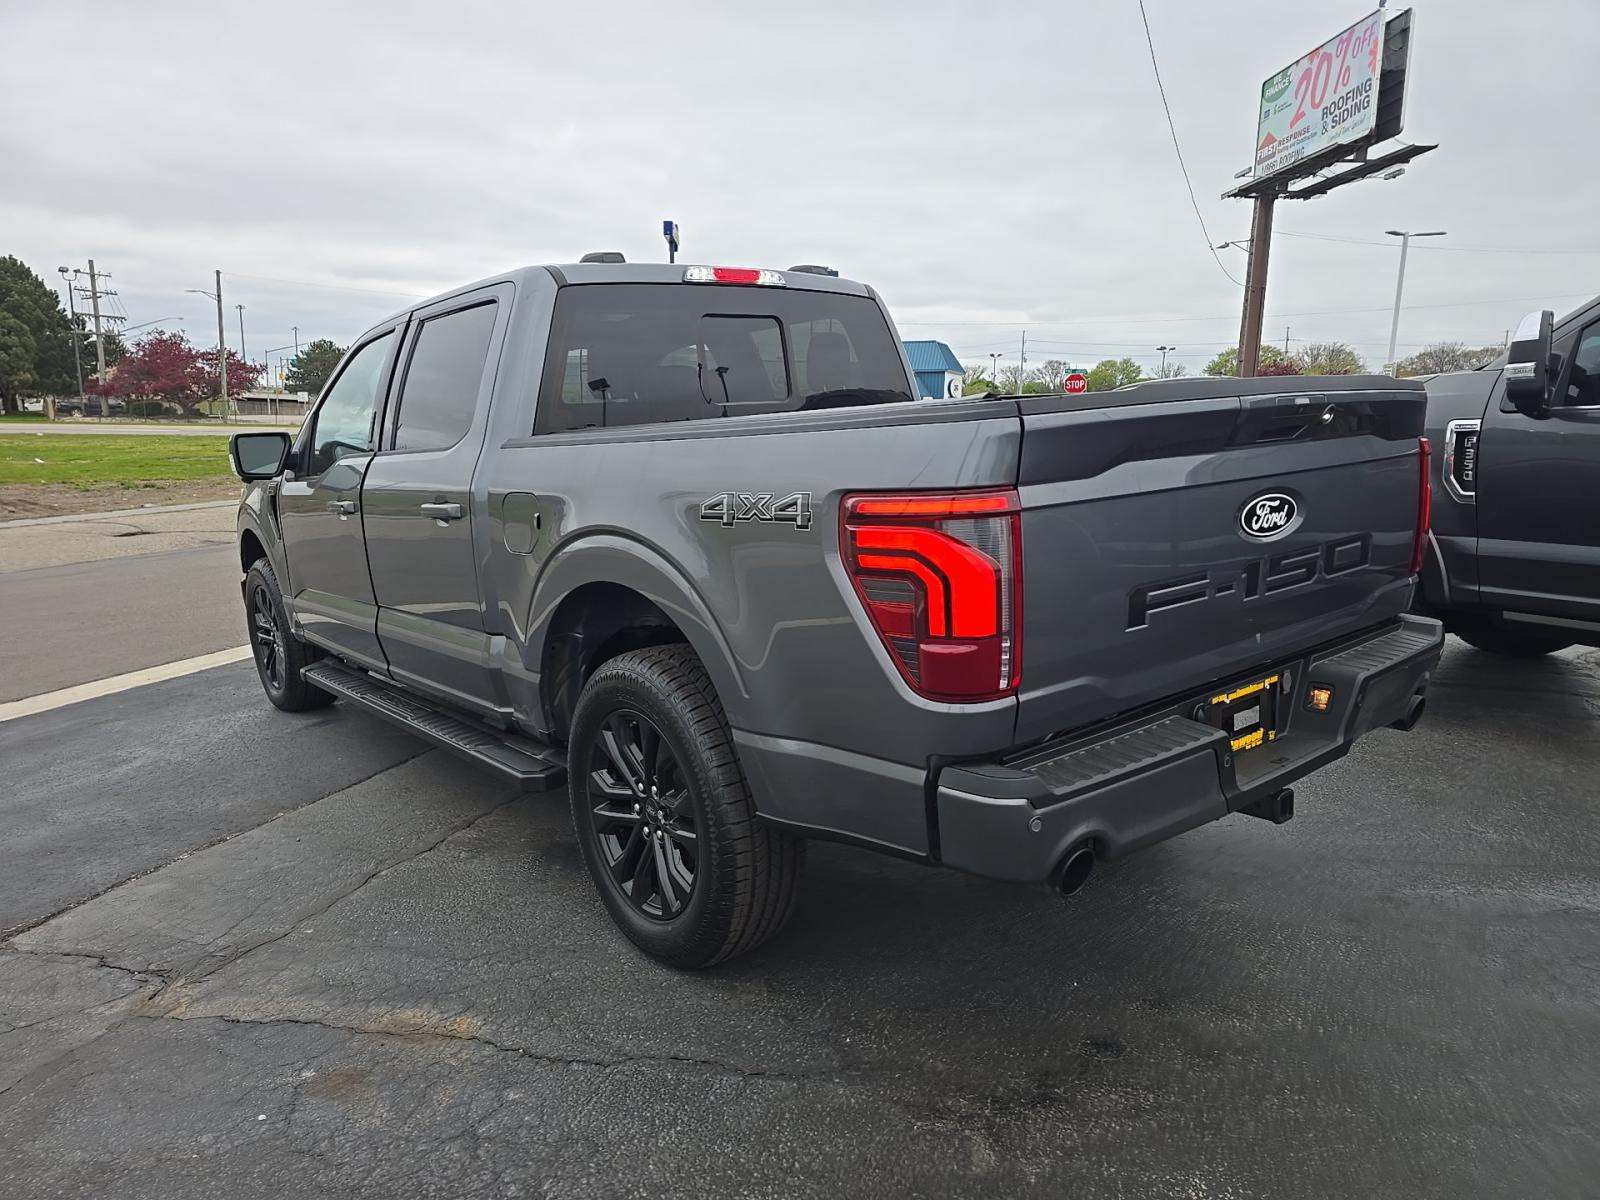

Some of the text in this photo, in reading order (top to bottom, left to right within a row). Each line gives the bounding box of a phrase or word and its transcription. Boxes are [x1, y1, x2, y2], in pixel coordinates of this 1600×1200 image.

[1290, 21, 1377, 128] 20% OFF
[1321, 78, 1372, 121] ROOFING
[1321, 121, 1329, 135] &
[1331, 94, 1371, 129] SIDING
[1278, 125, 1311, 147] RESPONSE
[1066, 380, 1085, 389] STOP
[1251, 500, 1289, 530] Ford
[1125, 532, 1373, 632] F-150
